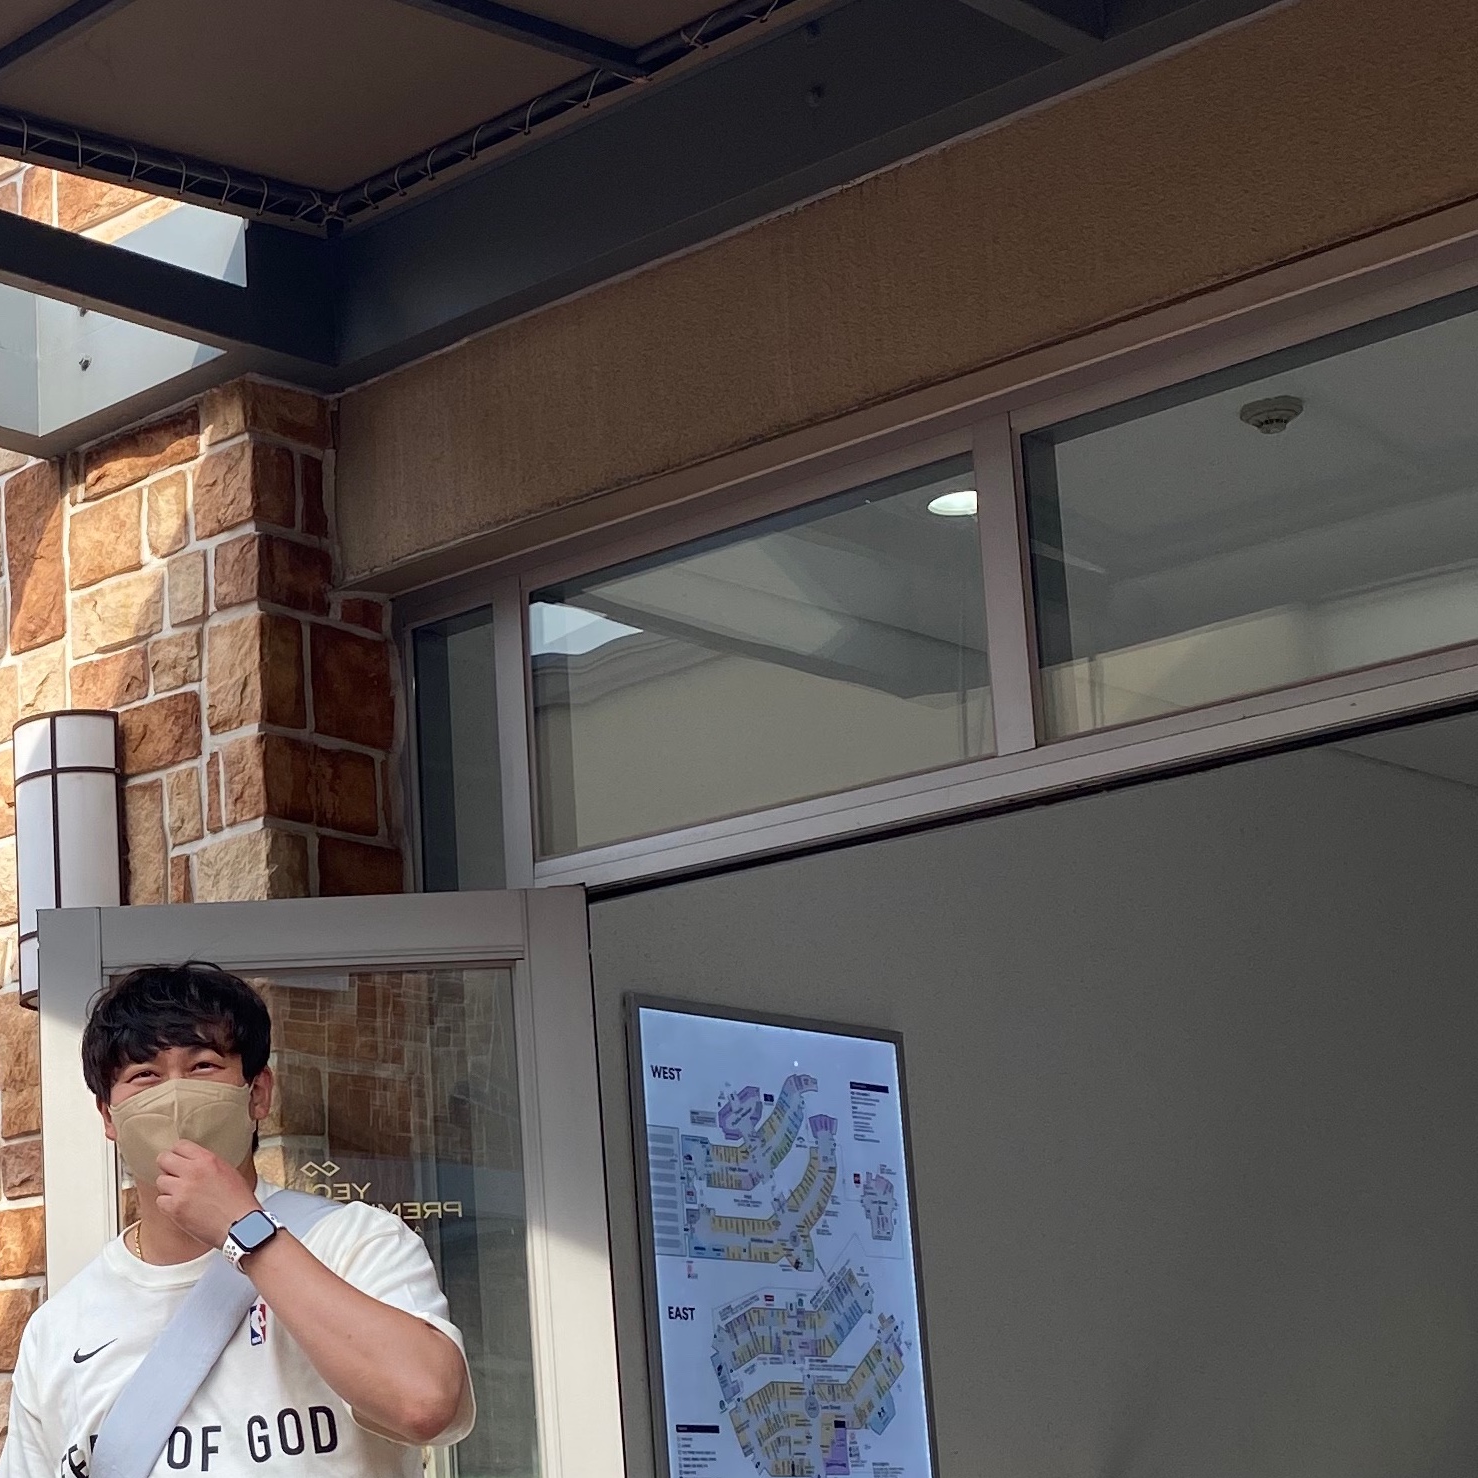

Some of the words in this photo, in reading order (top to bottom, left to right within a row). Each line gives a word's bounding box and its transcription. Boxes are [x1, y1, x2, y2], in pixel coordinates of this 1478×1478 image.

[650, 1064, 682, 1081] WEST
[667, 1305, 696, 1320] EAST
[166, 1425, 222, 1472] OF
[247, 1405, 339, 1464] GOD
